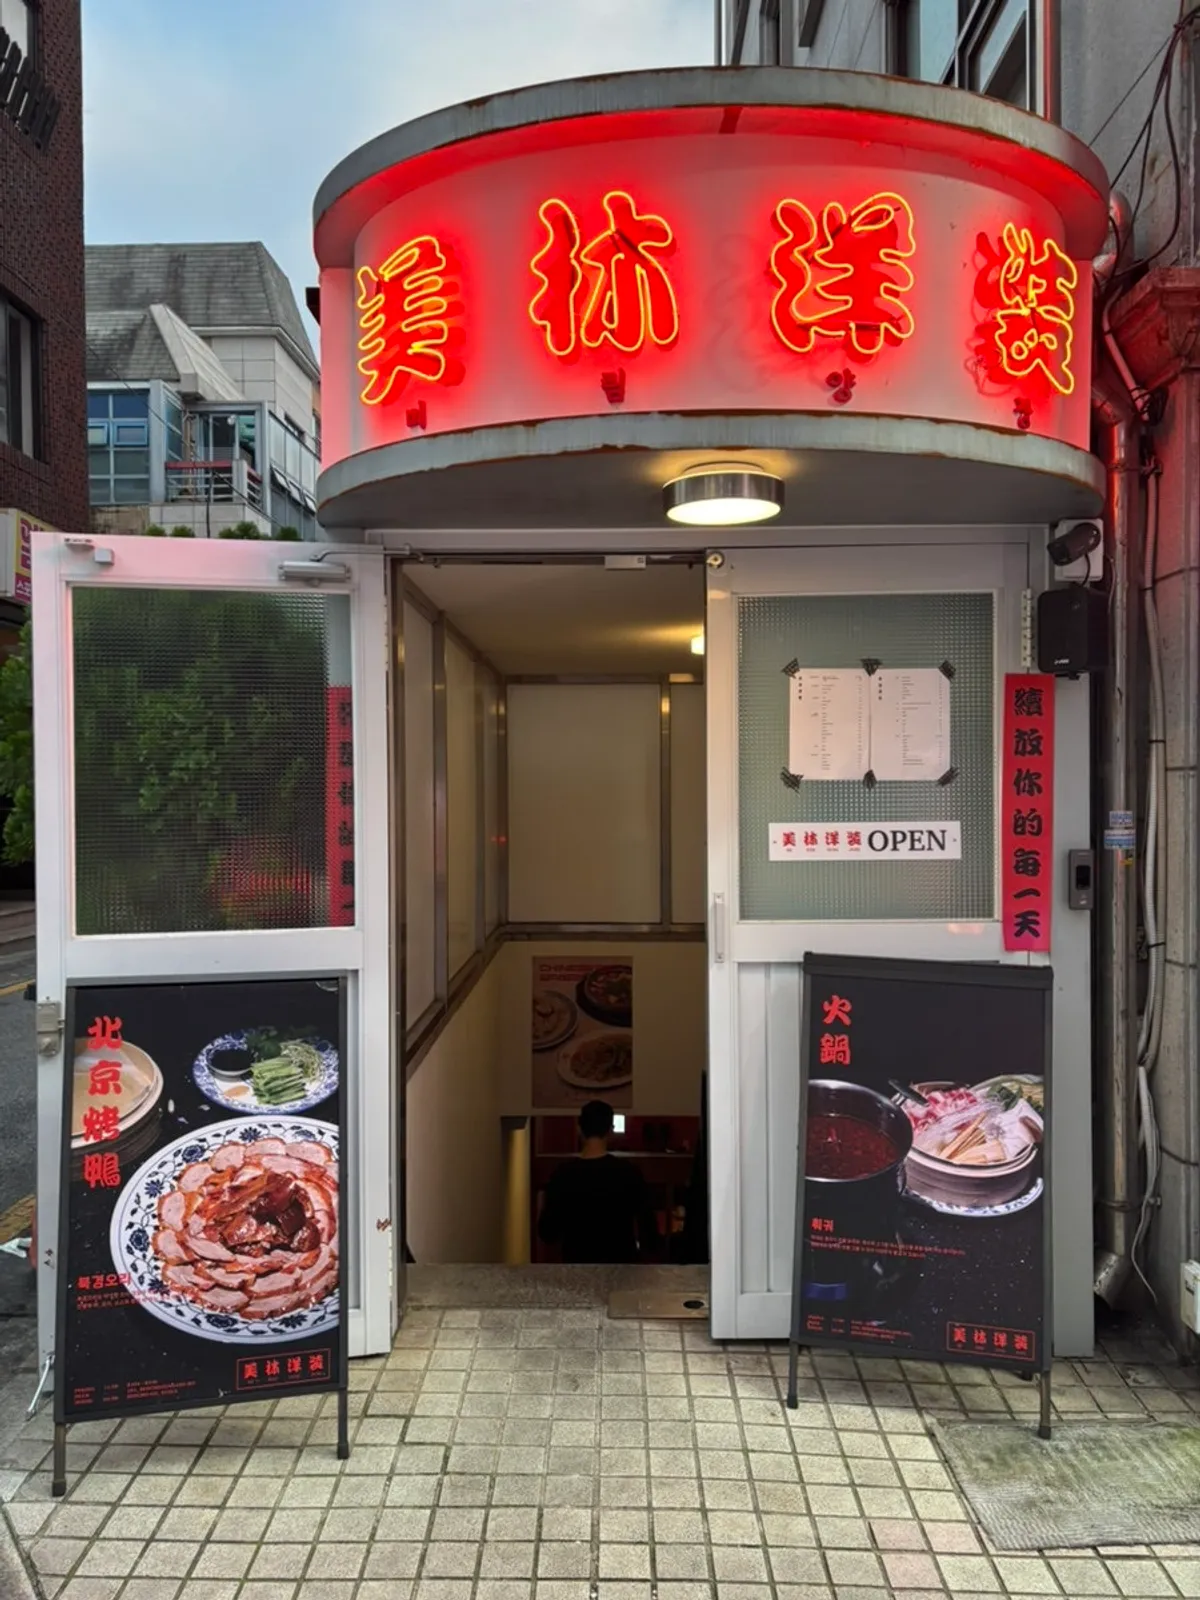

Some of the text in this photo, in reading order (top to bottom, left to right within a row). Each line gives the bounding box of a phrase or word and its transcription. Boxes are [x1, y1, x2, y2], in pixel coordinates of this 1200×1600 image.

[868, 829, 947, 852] OPEN
[820, 994, 852, 1065] 火鍋
[83, 1014, 122, 1189] 北京烤鴨
[77, 1272, 132, 1290] 북경오리
